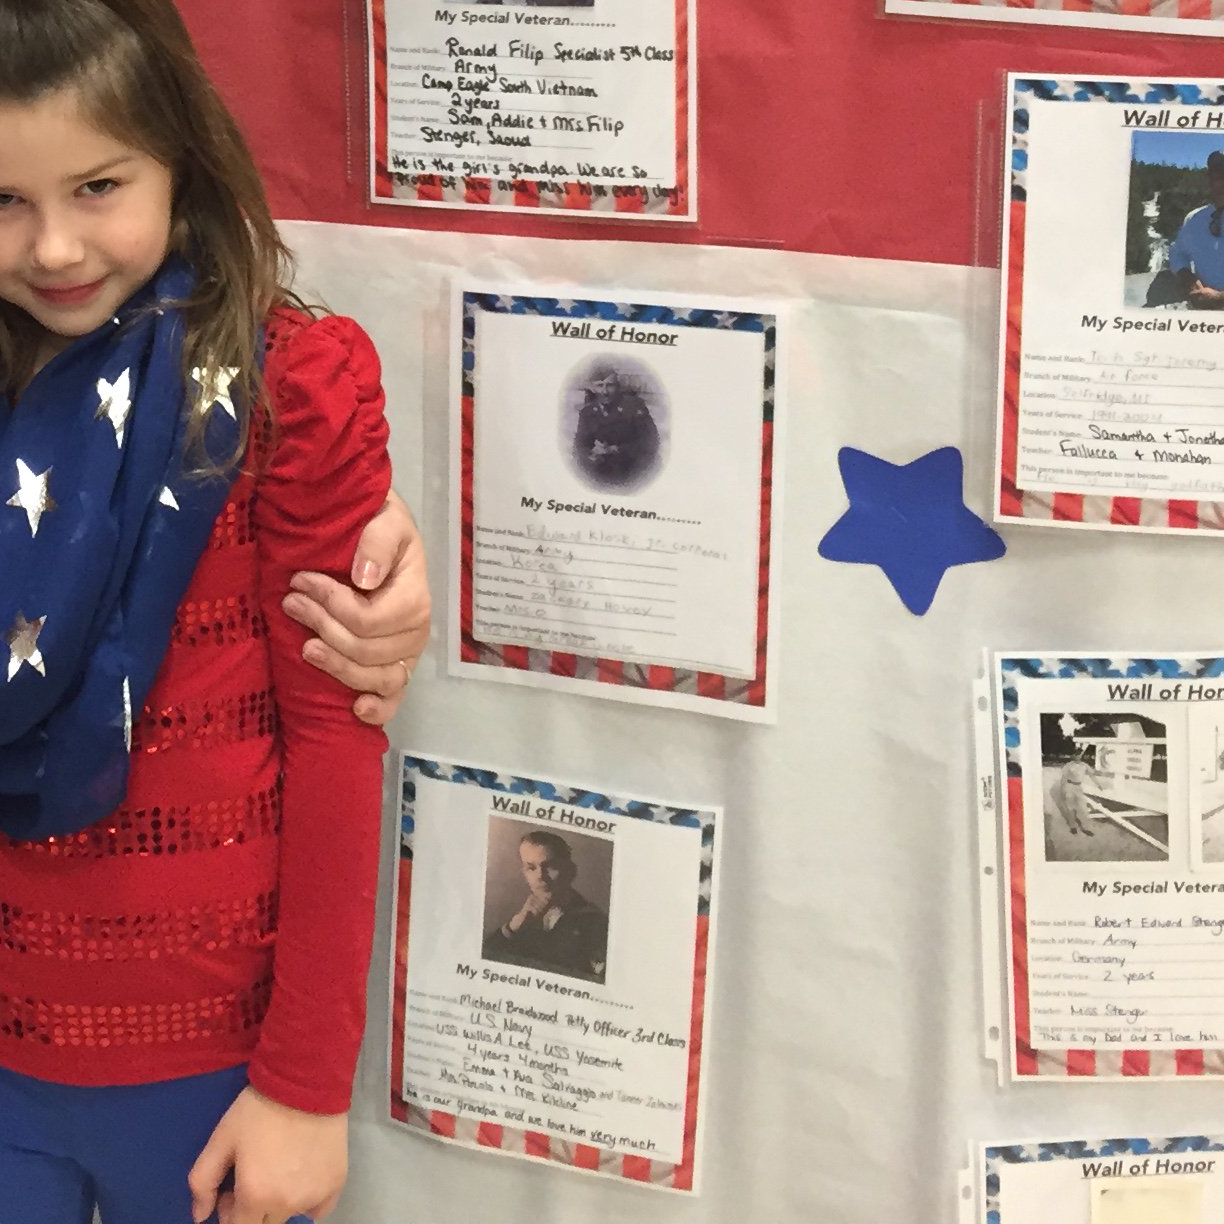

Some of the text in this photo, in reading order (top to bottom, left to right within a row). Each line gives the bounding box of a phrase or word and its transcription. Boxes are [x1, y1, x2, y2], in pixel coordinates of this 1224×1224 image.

[435, 9, 456, 24] My
[461, 11, 509, 25] Special
[509, 39, 544, 66] Filip
[554, 42, 615, 62] Specialist
[645, 45, 674, 61] Class
[454, 60, 497, 84] Army
[422, 74, 453, 92] Camp
[537, 80, 598, 98] Vietnam
[452, 93, 500, 113] 2 years
[587, 115, 624, 137] Filip
[1123, 110, 1170, 127] Wall
[1177, 111, 1199, 128] of
[393, 156, 409, 169] He
[413, 158, 425, 171] is
[432, 159, 454, 172] the
[552, 321, 678, 345] Wall of Honor
[1081, 315, 1224, 334] My Special Veter
[1089, 424, 1224, 445] Samantha Jonatha
[1153, 450, 1212, 465] Monahan
[521, 497, 542, 512] My
[547, 500, 596, 514] Special
[1107, 684, 1224, 700] Wall of Hon
[492, 795, 616, 832] Wall of Honor
[1083, 881, 1224, 896] My Special Vetera
[1094, 916, 1182, 927] Robert Edward
[1102, 934, 1137, 948] Army
[1072, 951, 1126, 966] Germany
[456, 964, 478, 979] My
[483, 968, 530, 989] Special
[1104, 971, 1112, 981] 2
[460, 993, 502, 1014] Michael
[632, 1030, 655, 1044] 3rd
[657, 1032, 686, 1049] Class
[504, 1018, 533, 1038] Navy
[468, 1043, 476, 1056] 4
[480, 1048, 510, 1063] years
[519, 1054, 528, 1067] 4
[544, 1044, 570, 1061] USS
[619, 1136, 656, 1150] much
[1083, 1159, 1215, 1178] Wall of Honor
